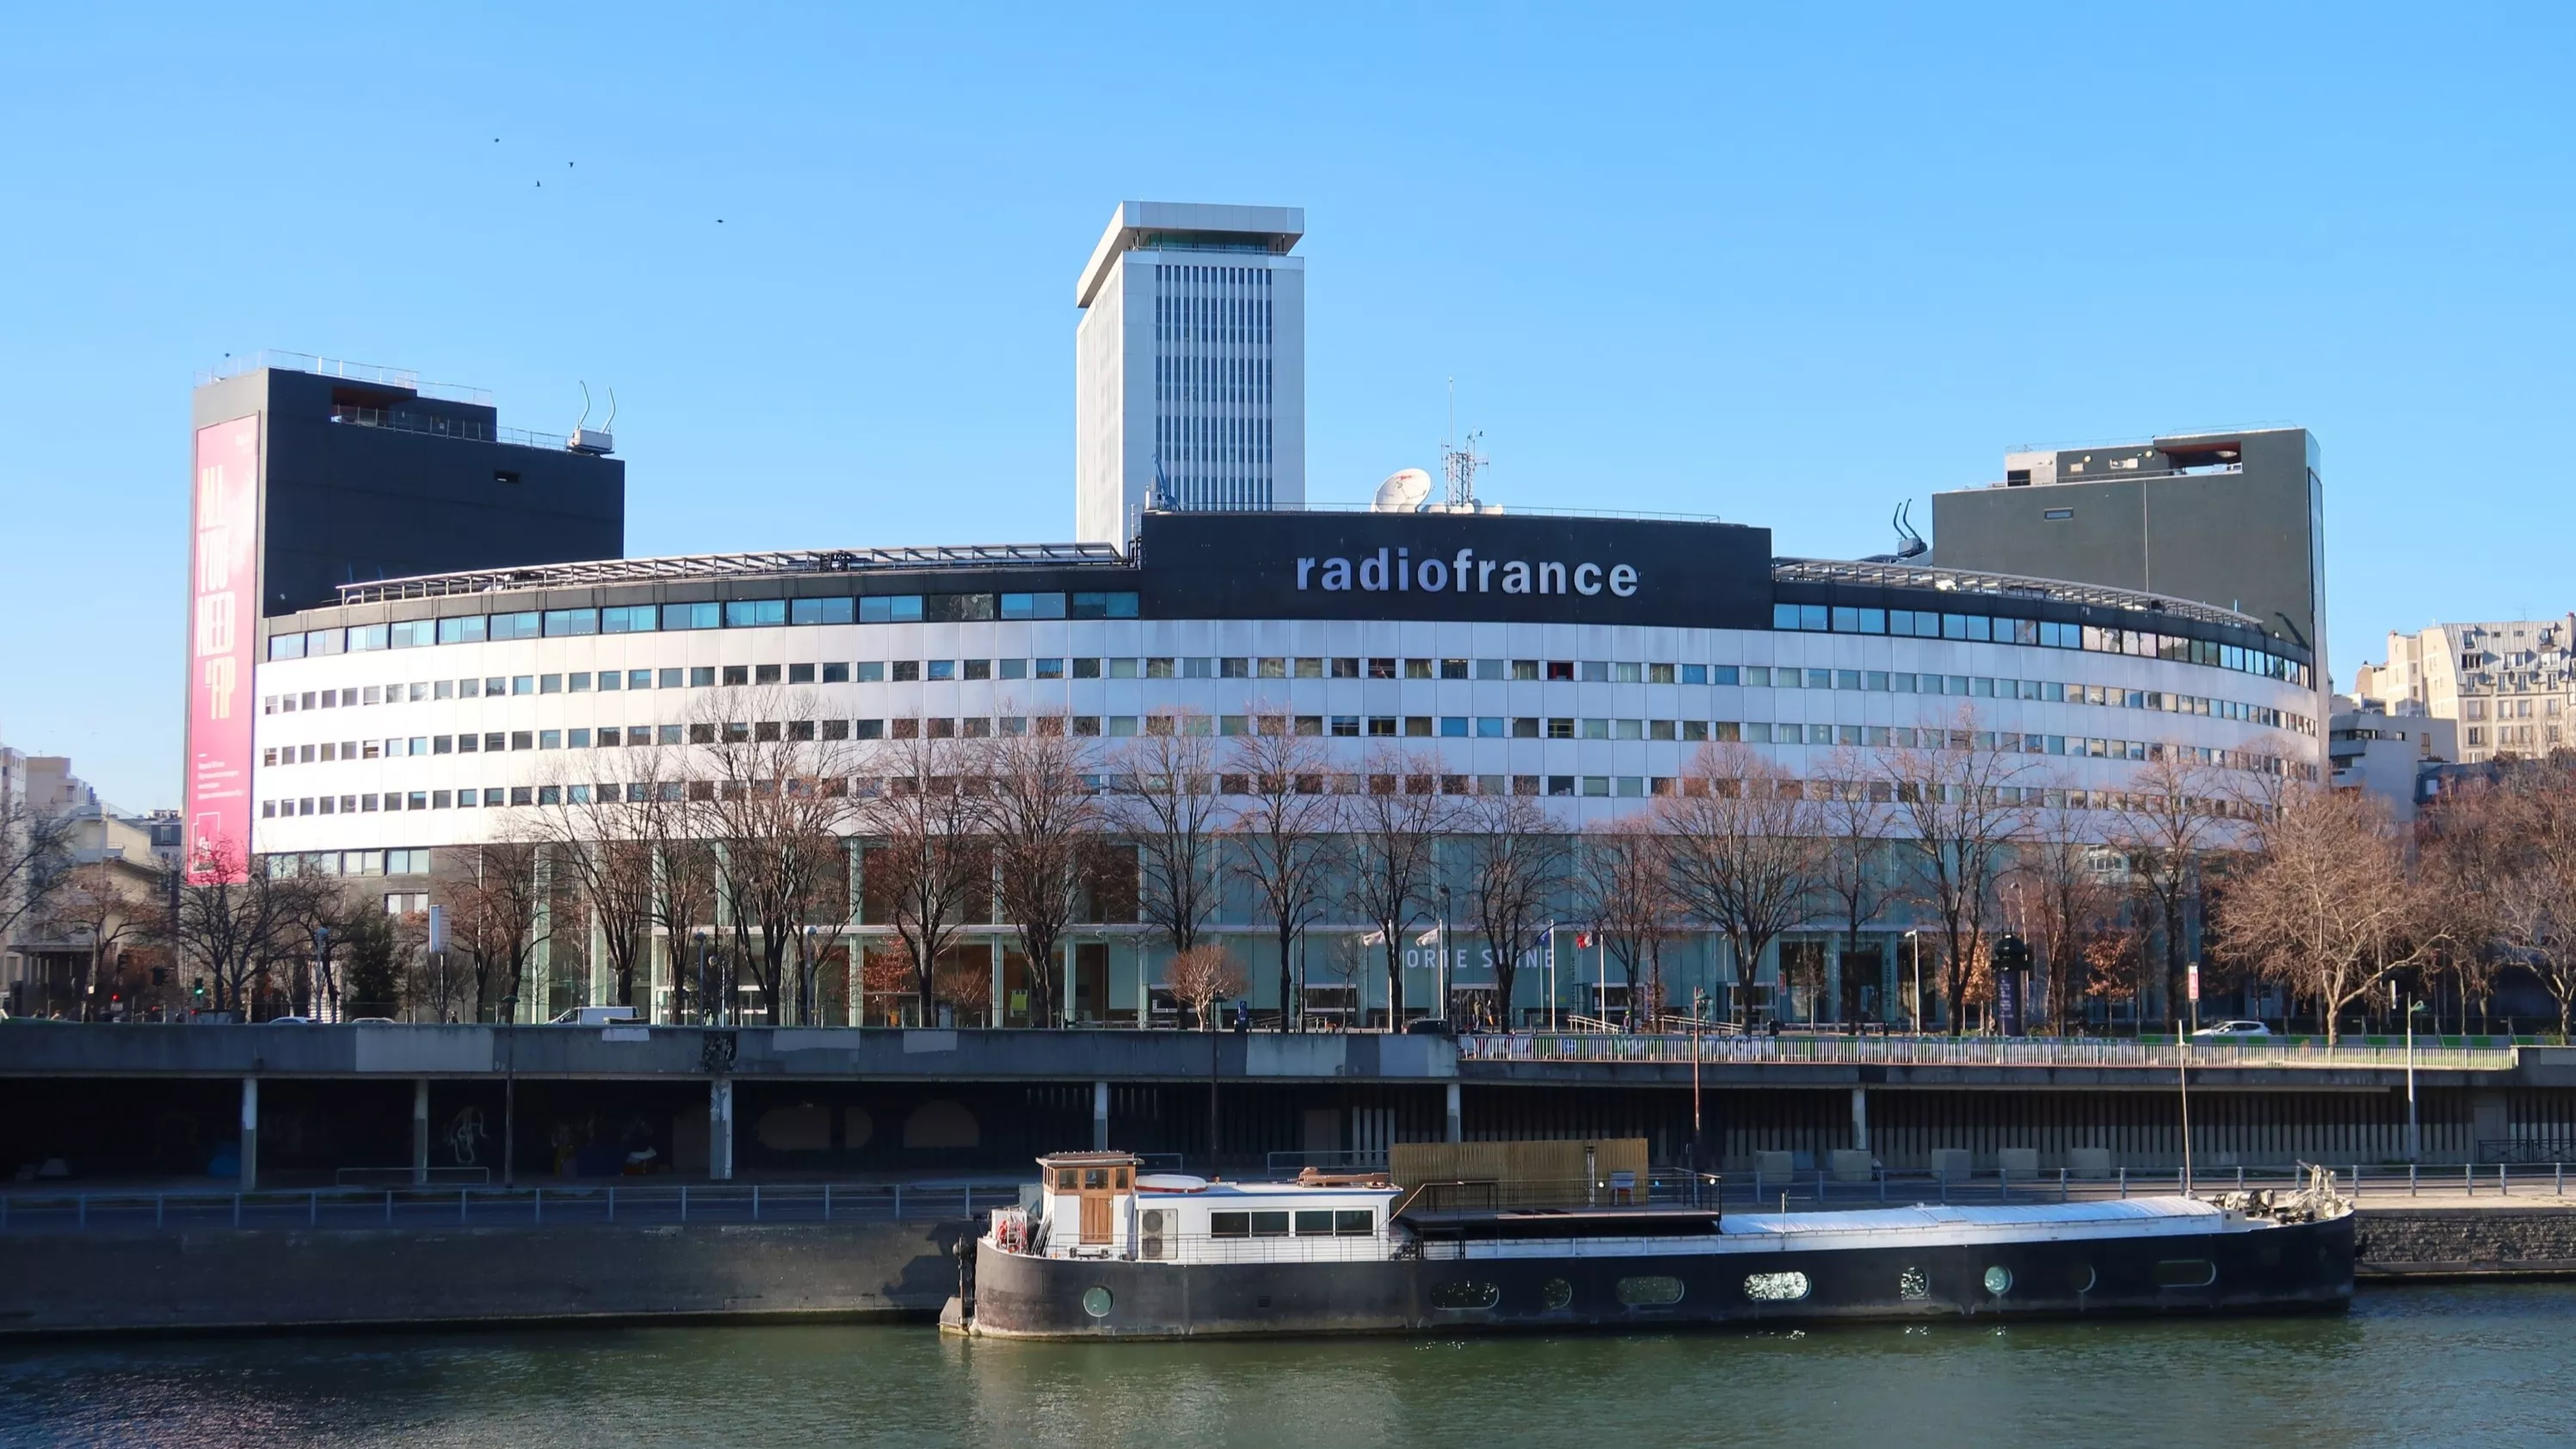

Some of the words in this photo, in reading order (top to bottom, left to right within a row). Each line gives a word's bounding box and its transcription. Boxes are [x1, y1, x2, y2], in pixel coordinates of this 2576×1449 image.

[199, 527, 228, 592] YOU
[1297, 547, 1638, 596] radiofrance
[197, 591, 236, 657] NEED
[1390, 949, 1467, 968] ORTE
